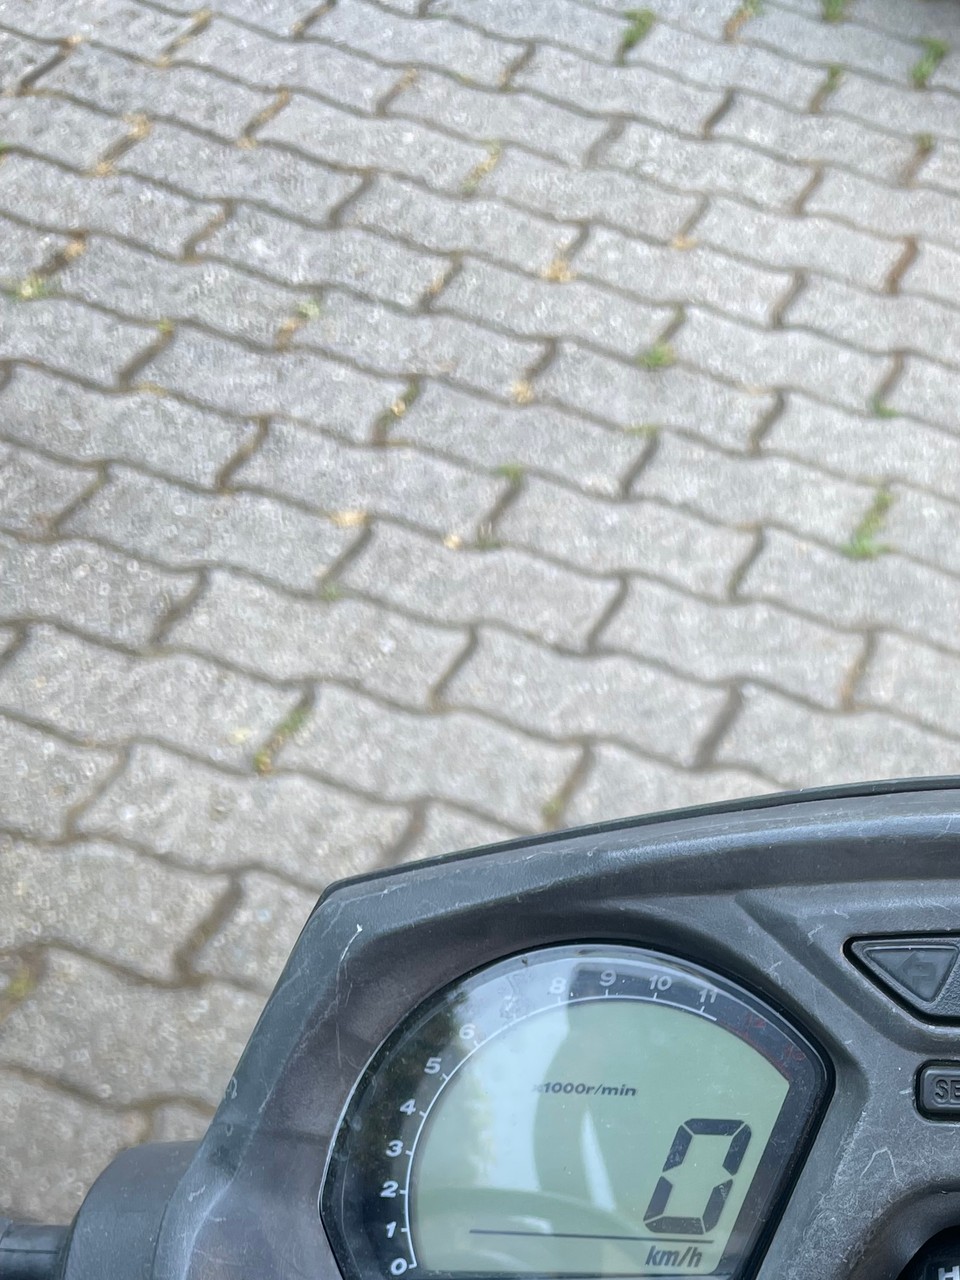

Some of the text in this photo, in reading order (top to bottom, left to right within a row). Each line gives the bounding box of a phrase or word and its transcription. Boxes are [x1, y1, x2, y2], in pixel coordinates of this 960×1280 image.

[549, 977, 566, 994] 8
[600, 969, 617, 987] 9
[649, 974, 672, 991] 10
[699, 988, 717, 1004] 11
[459, 1023, 475, 1040] 6
[424, 1057, 441, 1074] 5
[400, 1099, 416, 1115] 4
[386, 1140, 403, 1157] 3
[642, 1118, 752, 1235] 0
[380, 1181, 398, 1198] 2
[386, 1221, 397, 1239] 1
[645, 1246, 702, 1268] km/h
[390, 1257, 408, 1276] 0
